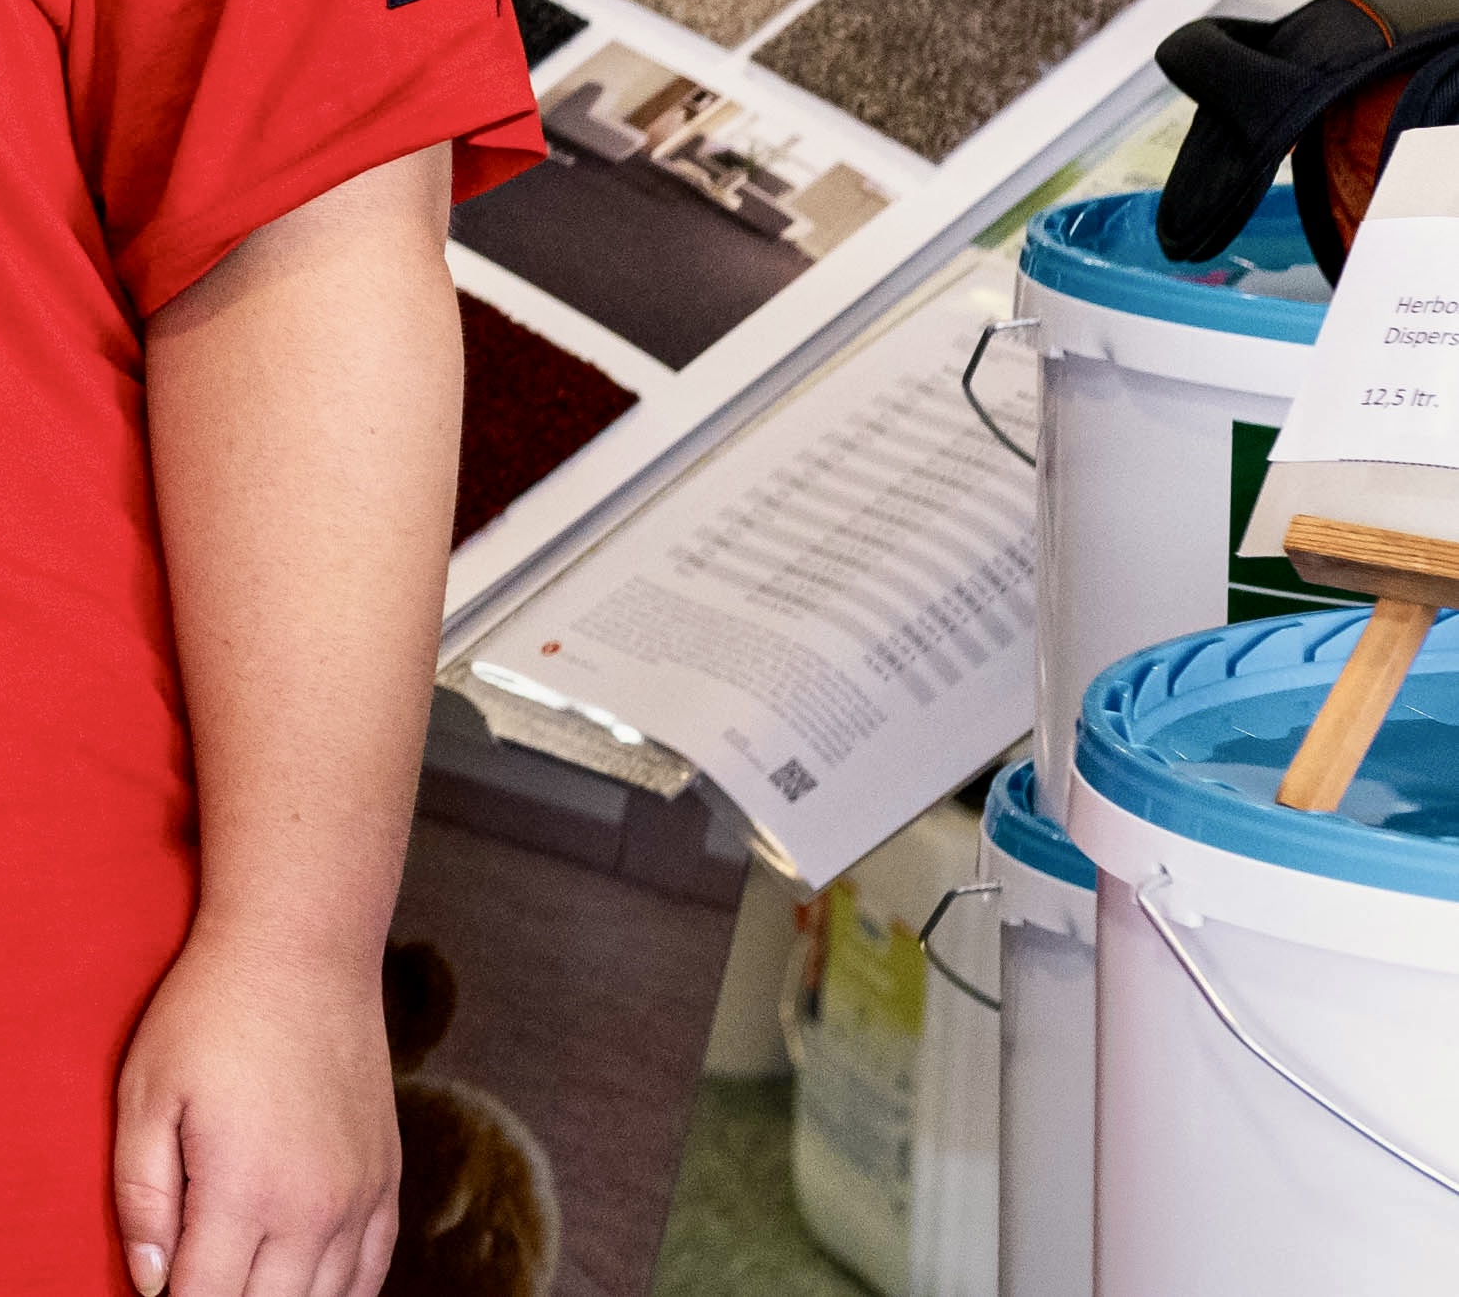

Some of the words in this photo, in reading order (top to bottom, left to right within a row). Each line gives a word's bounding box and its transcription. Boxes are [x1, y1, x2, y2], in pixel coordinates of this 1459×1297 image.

[1383, 326, 1459, 348] Dispers
[1360, 387, 1407, 409] 12,5
[1410, 386, 1440, 409] ltr.
